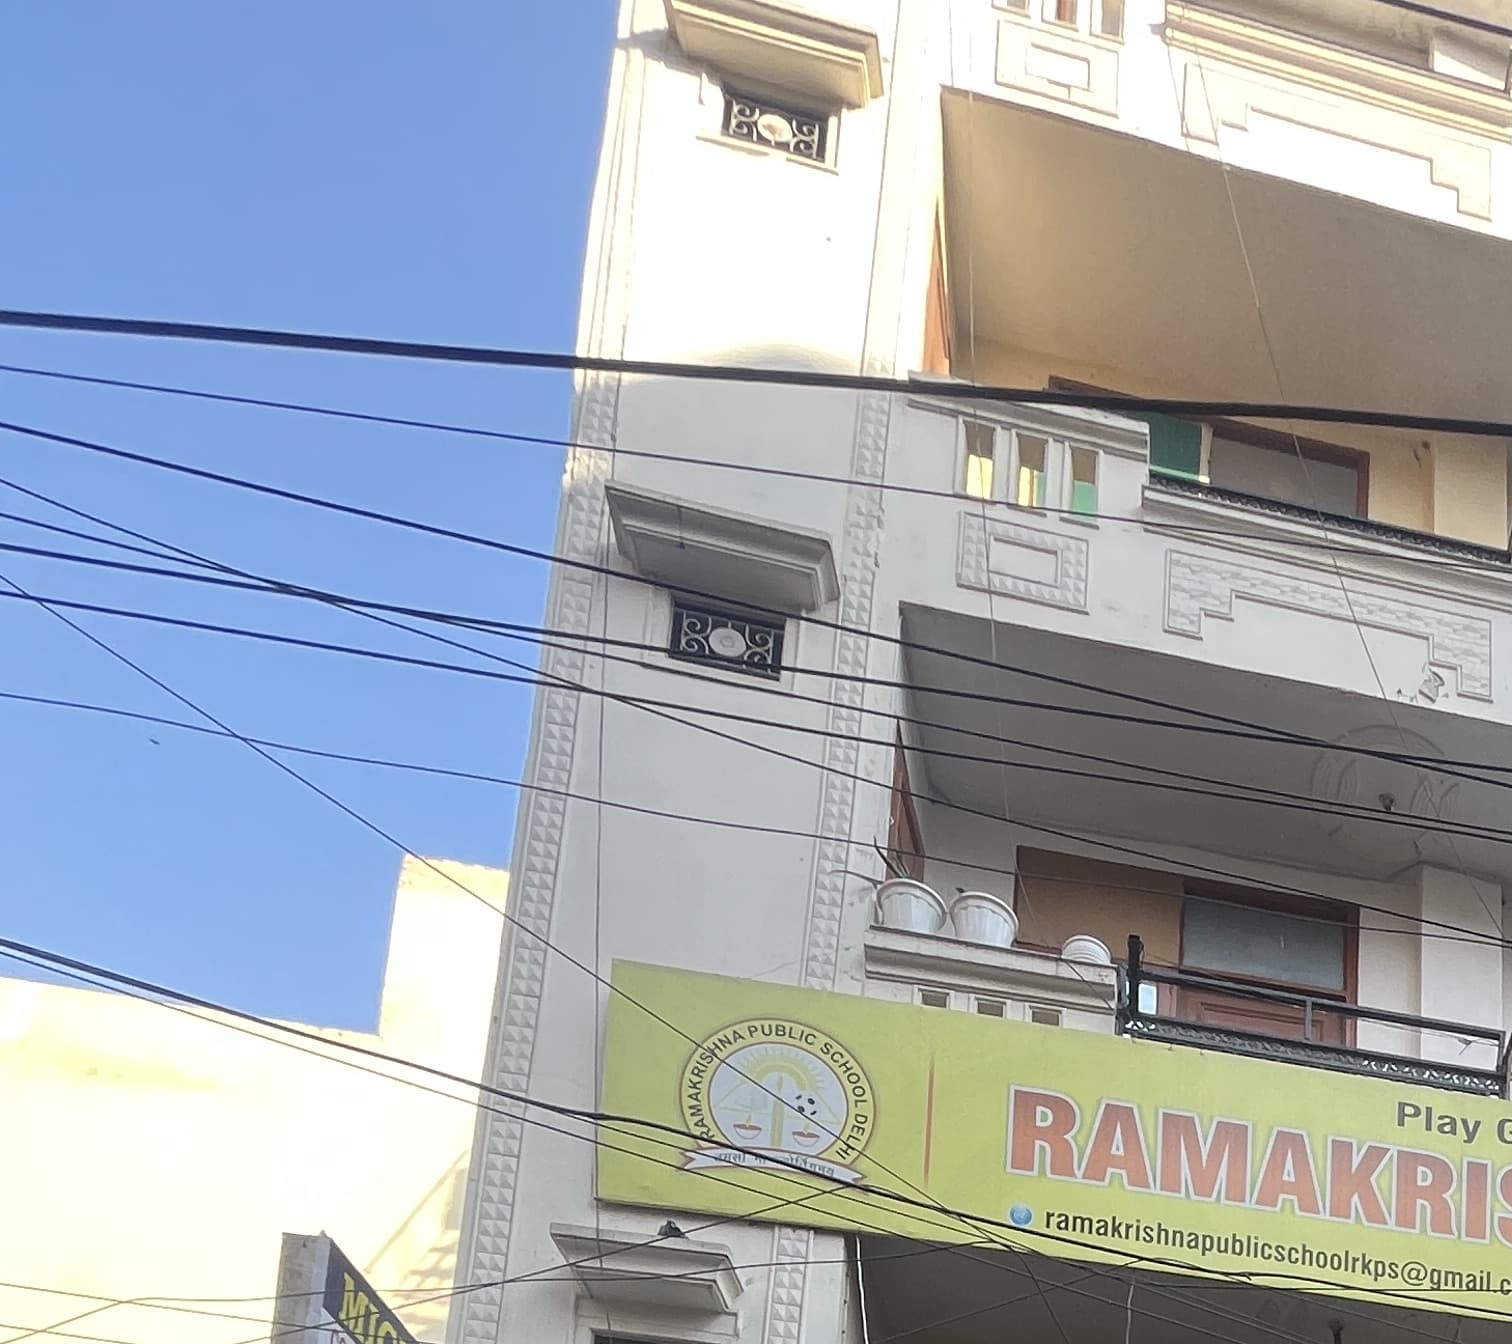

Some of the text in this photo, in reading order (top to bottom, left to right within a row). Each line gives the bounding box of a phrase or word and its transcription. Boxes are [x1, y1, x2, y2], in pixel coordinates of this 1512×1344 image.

[688, 1024, 869, 1160] RAMAKRISHNA PUBLIC SCHOOL DELHI
[1397, 1101, 1482, 1143] Play
